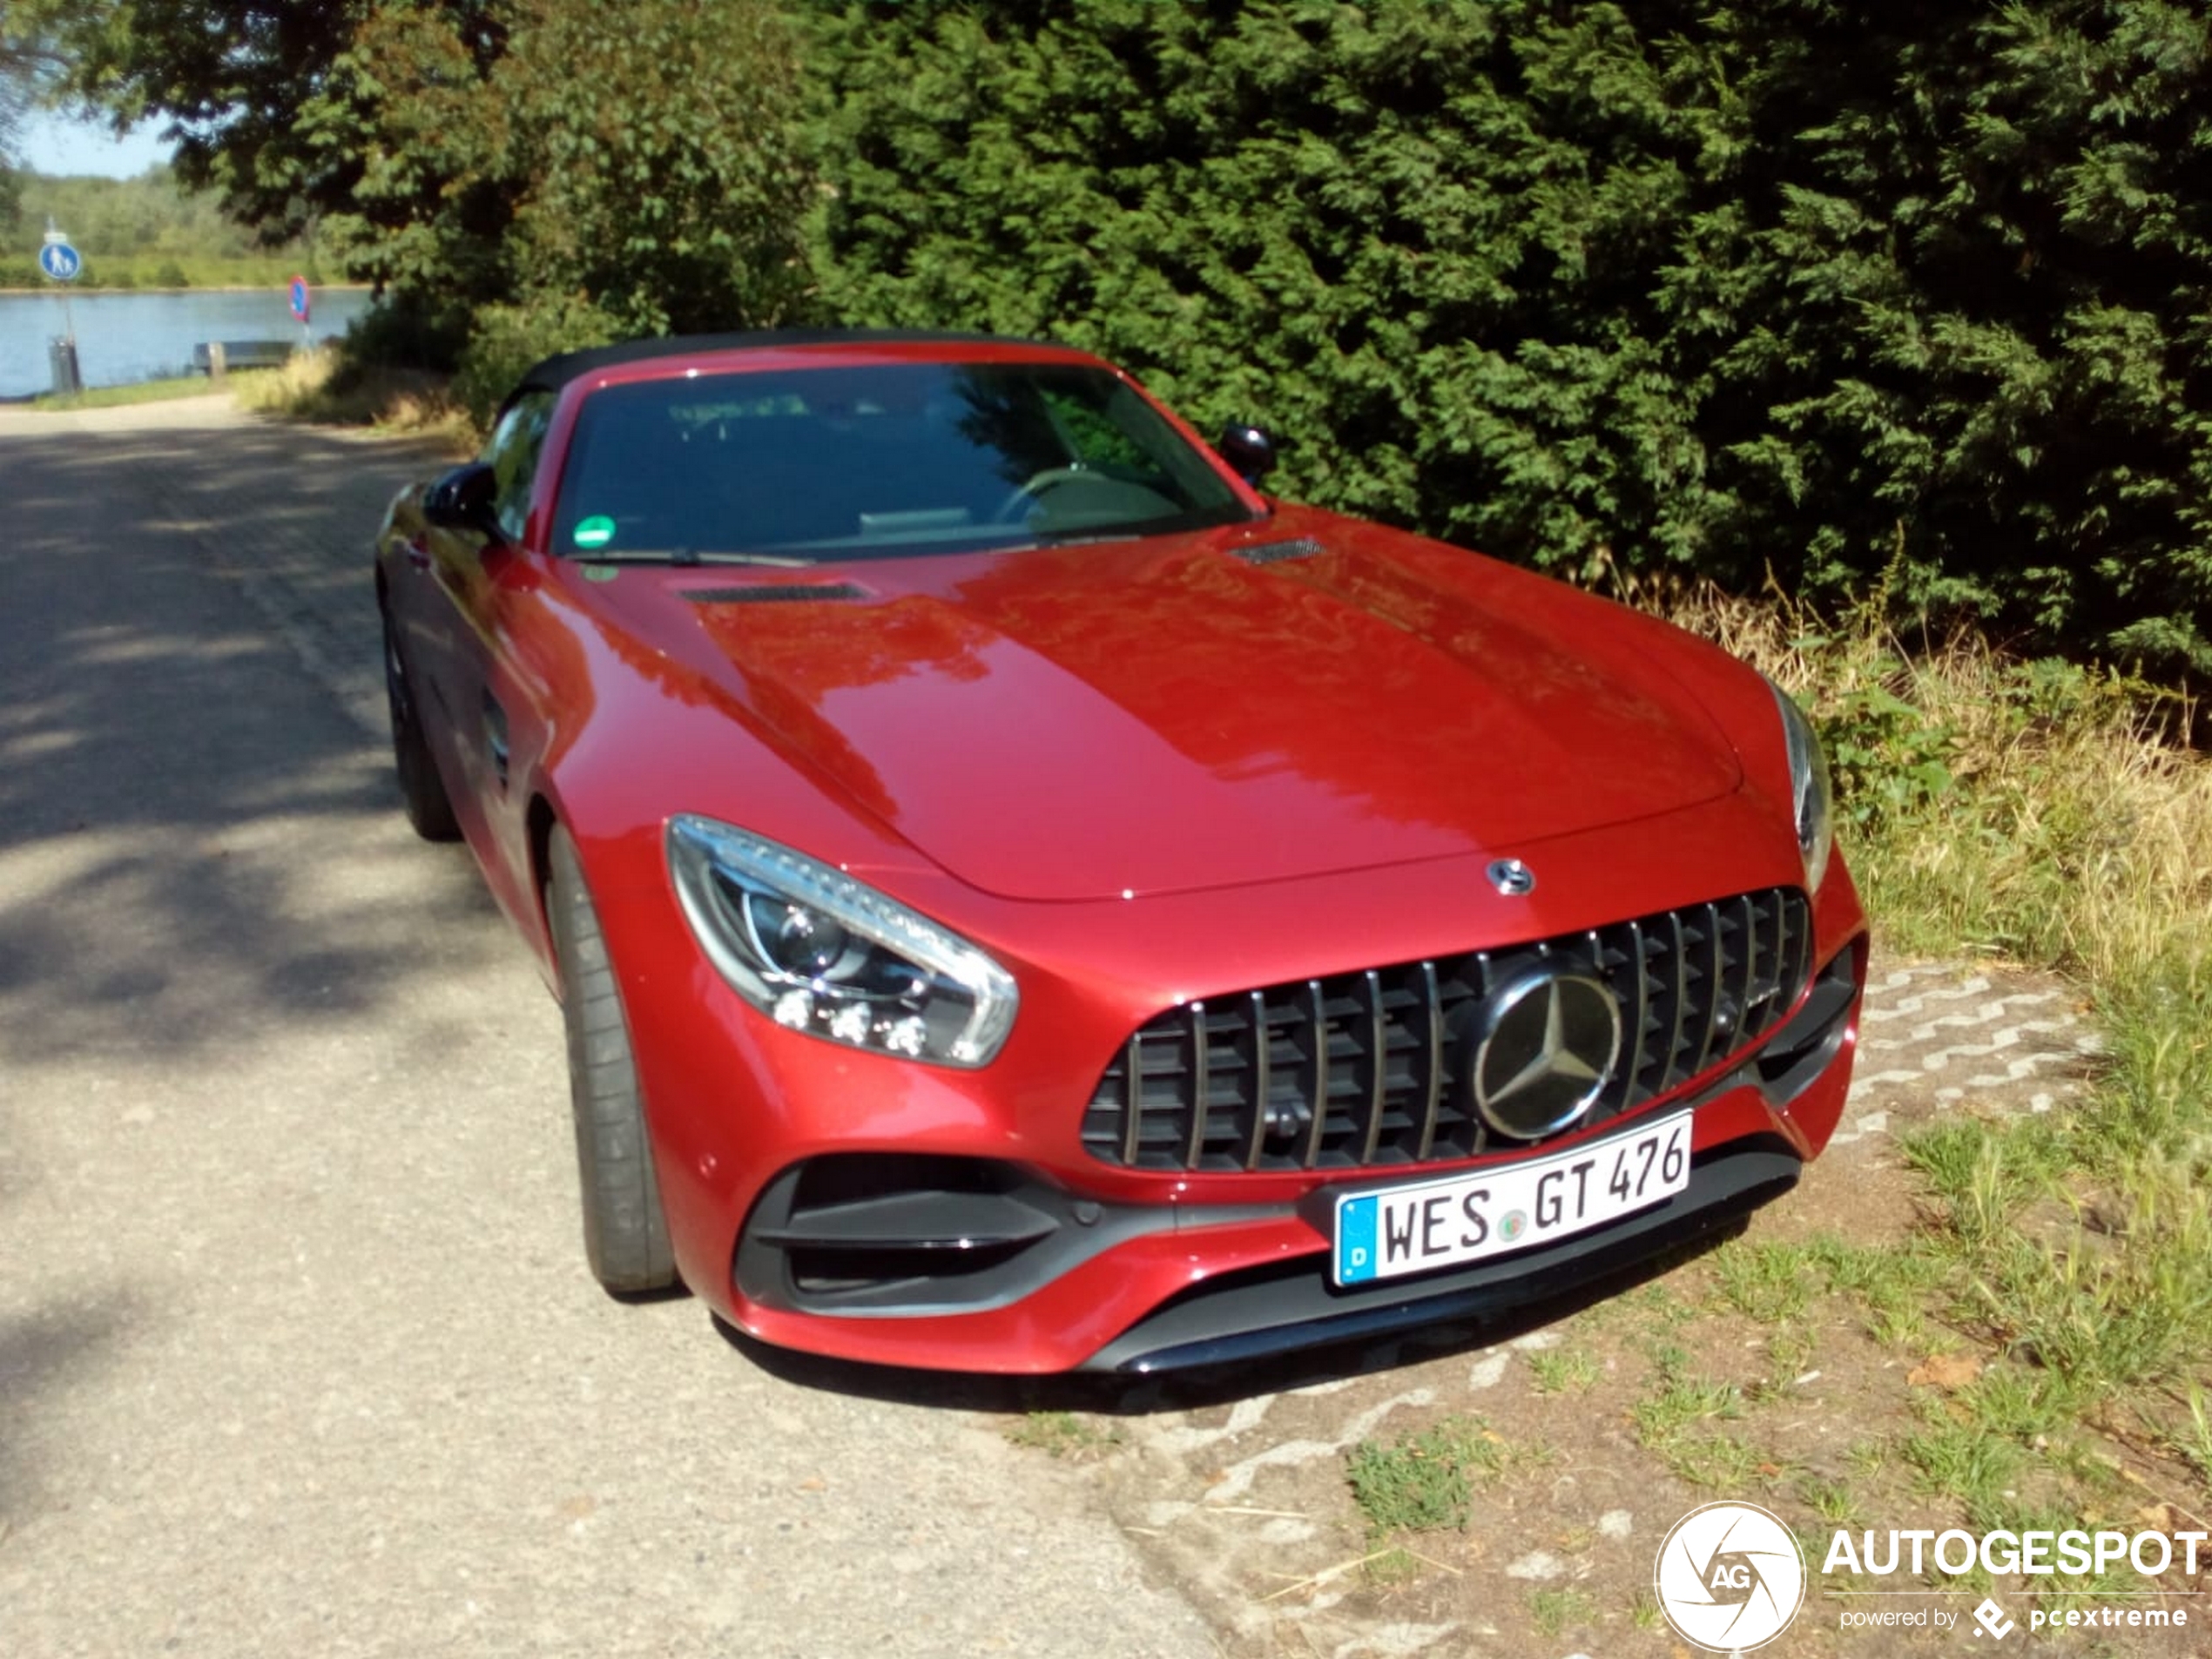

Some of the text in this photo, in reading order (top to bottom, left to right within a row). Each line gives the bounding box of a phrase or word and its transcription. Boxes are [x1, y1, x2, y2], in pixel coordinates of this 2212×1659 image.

[1386, 1128, 1683, 1263] WES GT 476
[1352, 1247, 1366, 1267] D
